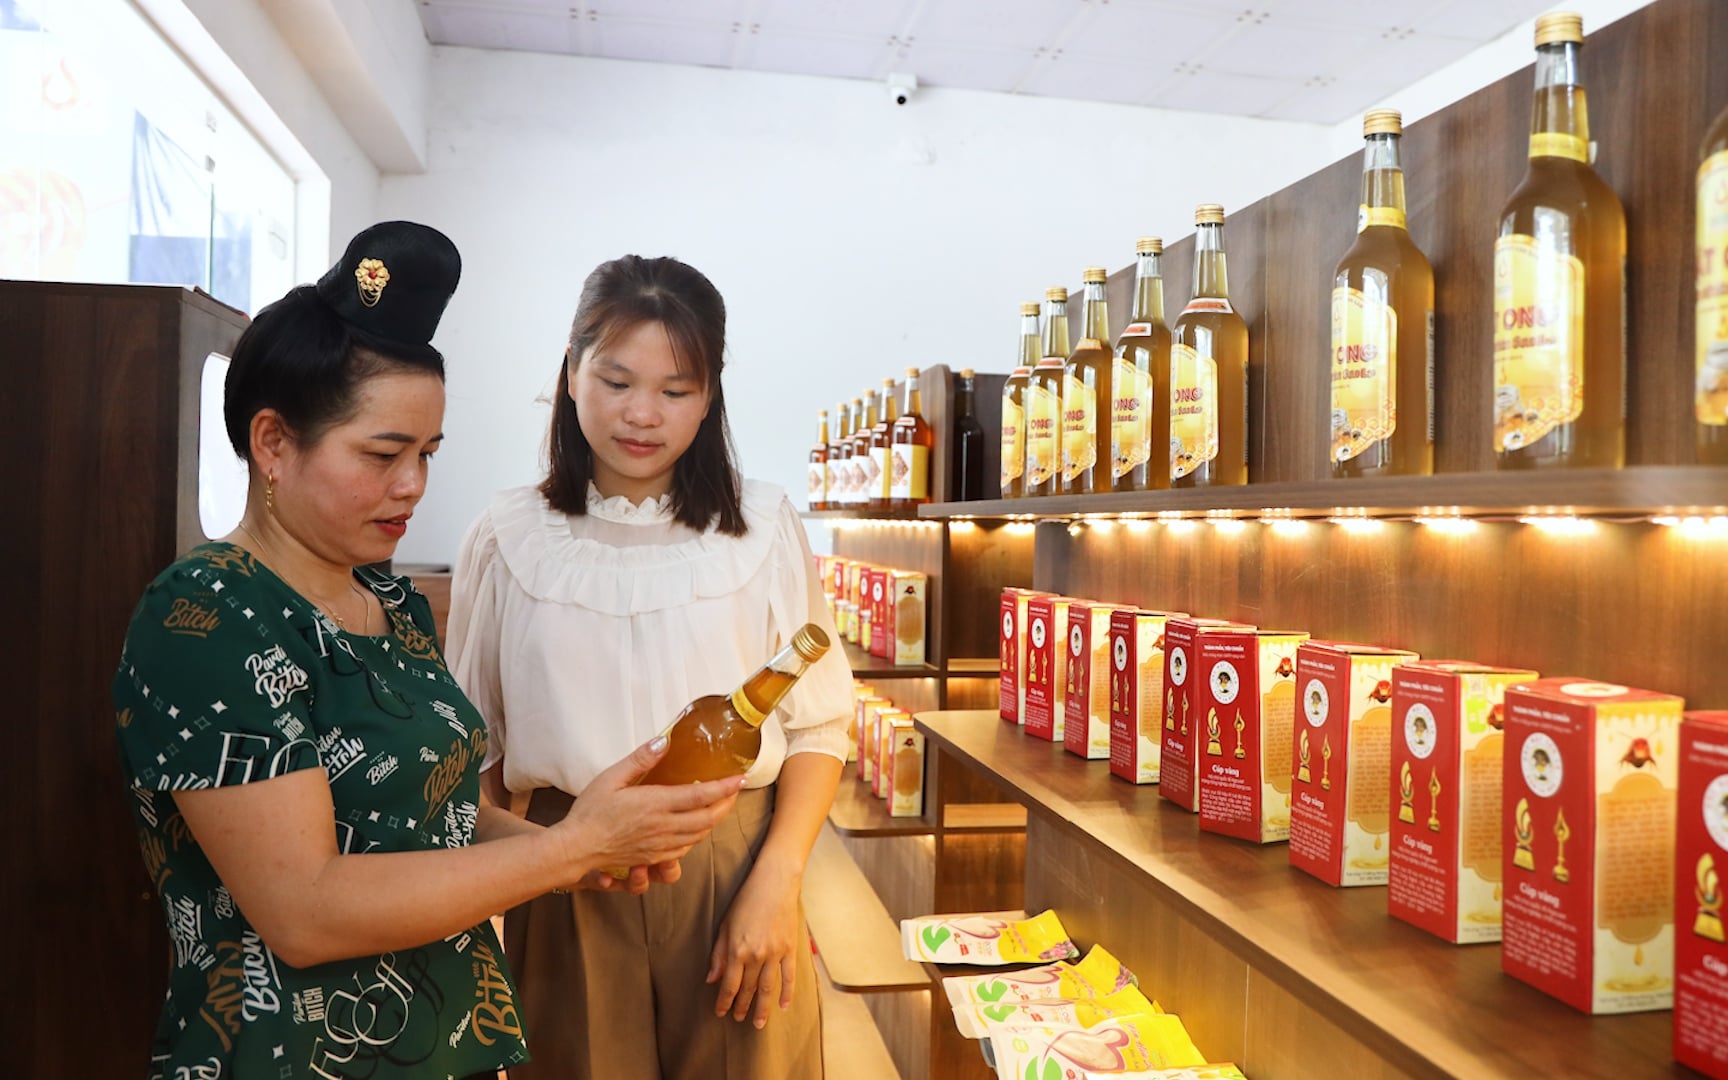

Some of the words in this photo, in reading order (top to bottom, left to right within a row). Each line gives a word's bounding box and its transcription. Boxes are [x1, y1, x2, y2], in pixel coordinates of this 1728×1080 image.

[163, 598, 221, 631] Bitch
[366, 755, 398, 786] Bitch
[303, 987, 325, 1022] BITCH
